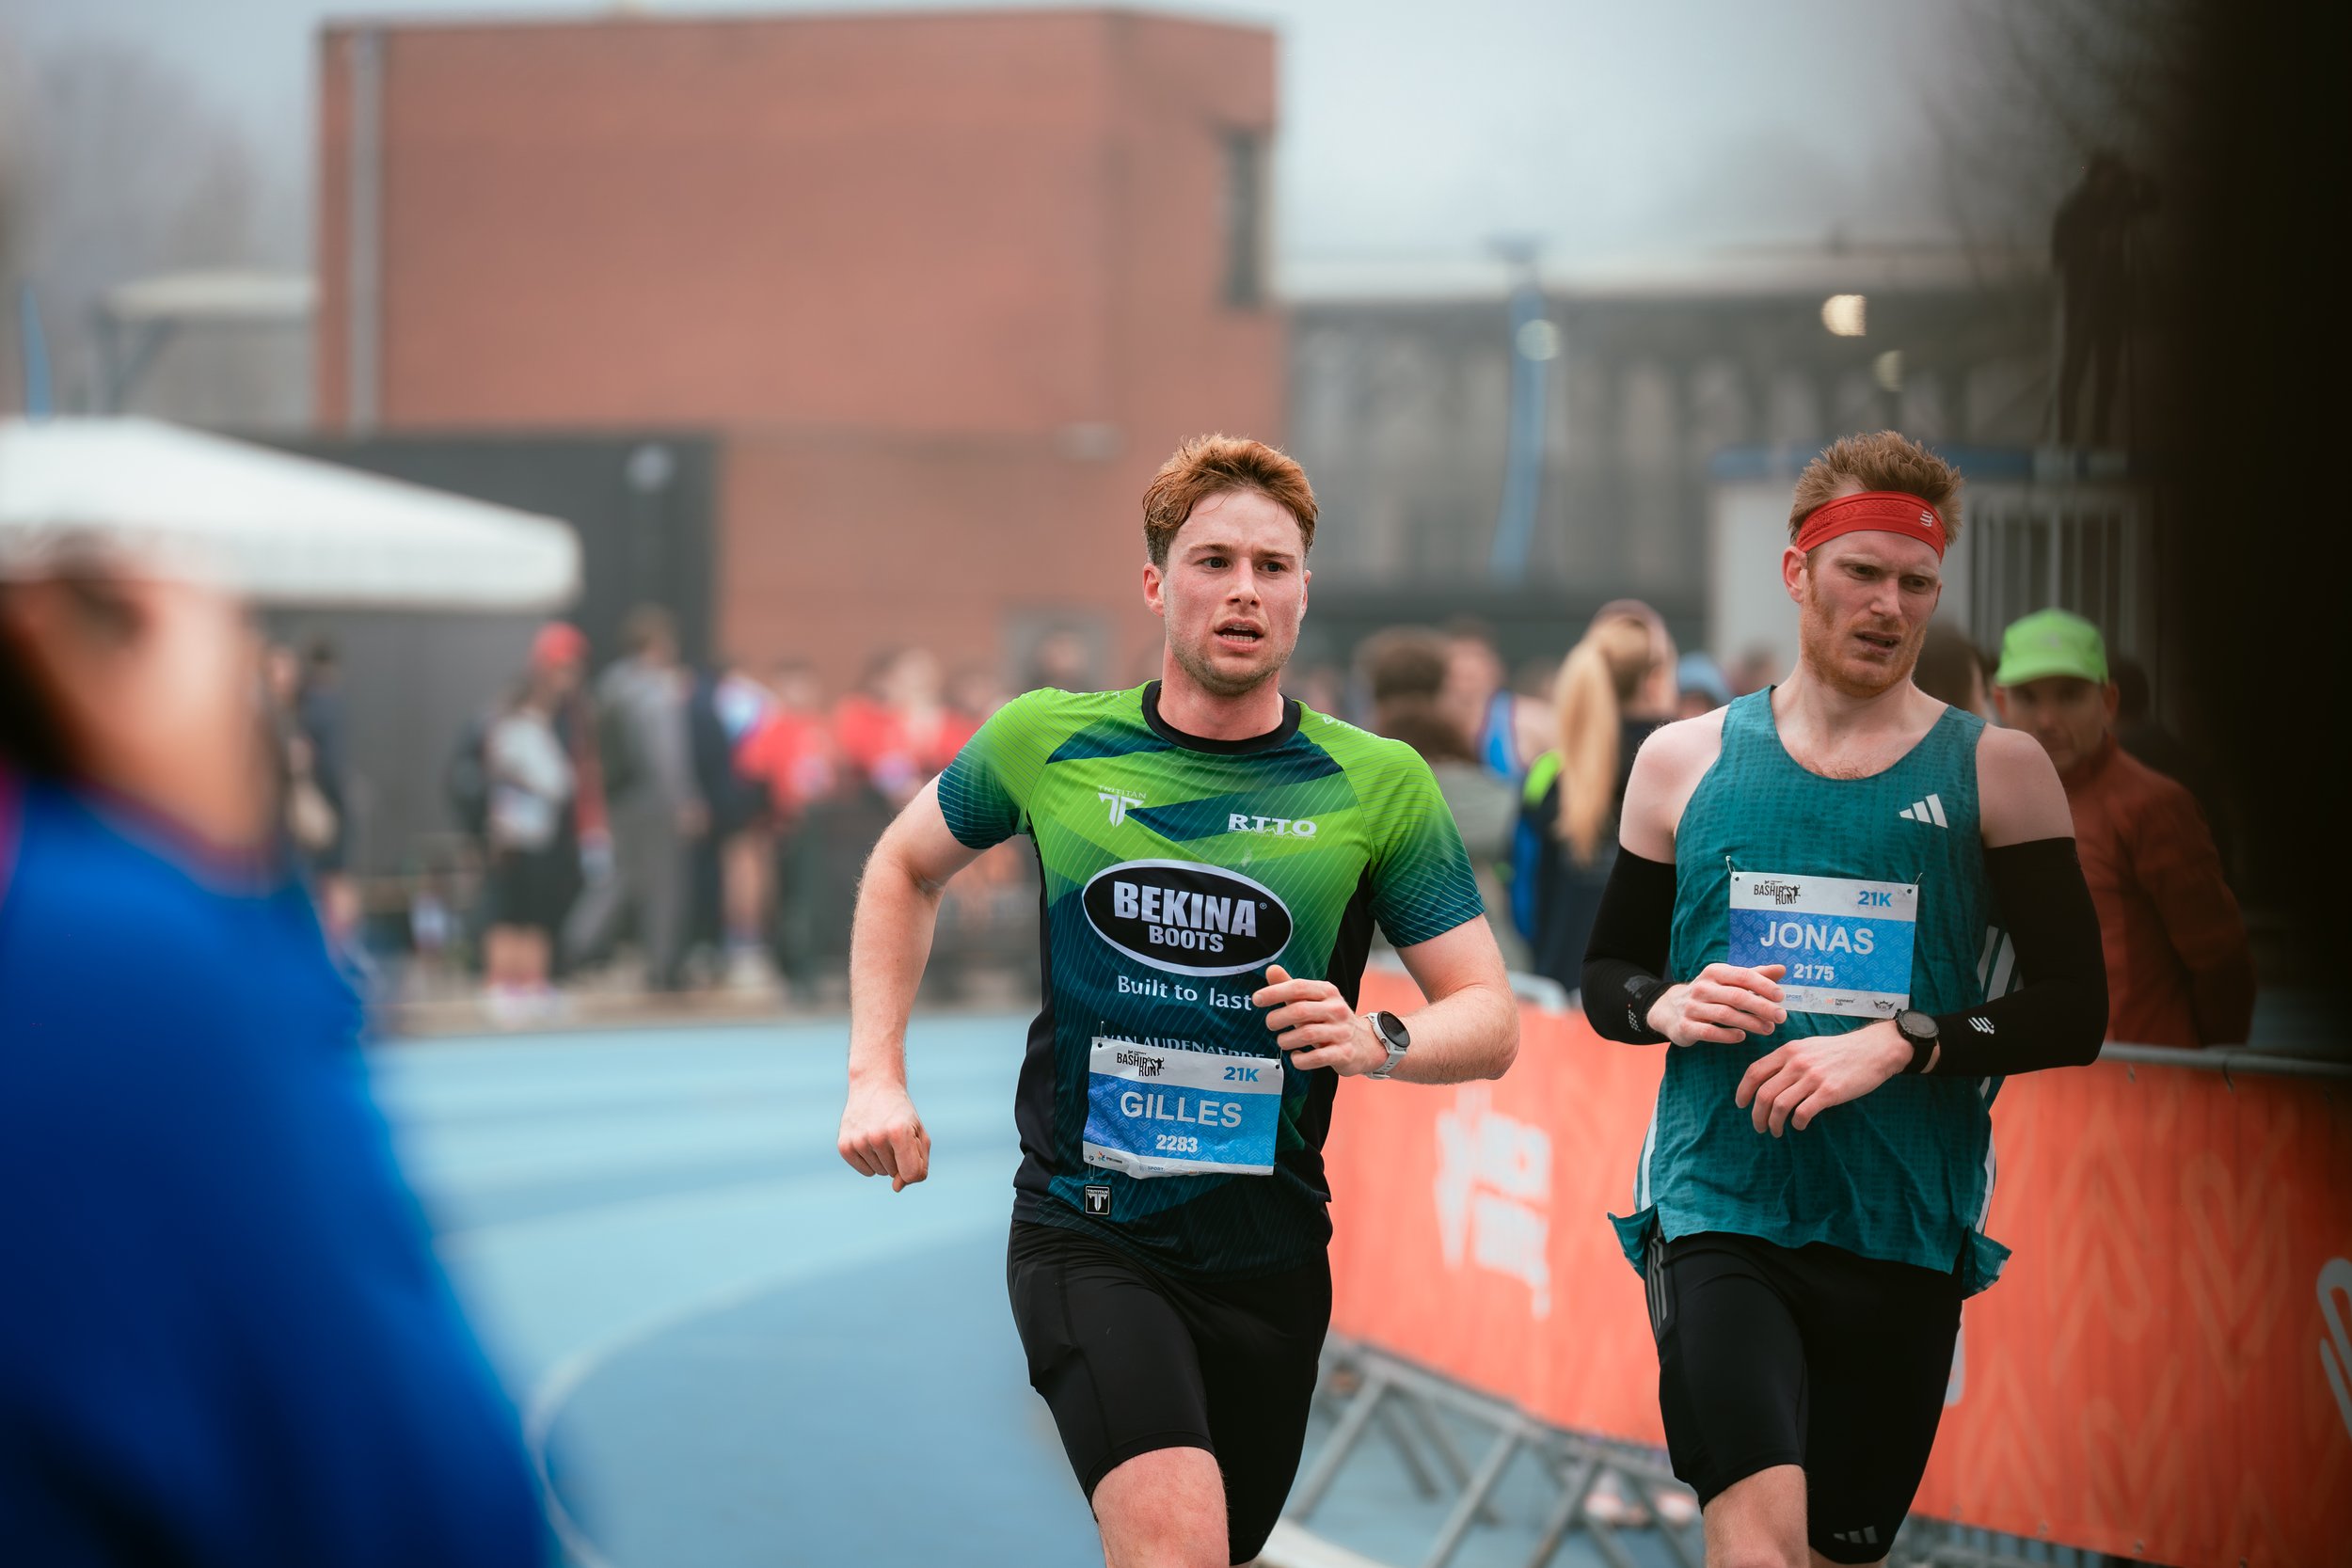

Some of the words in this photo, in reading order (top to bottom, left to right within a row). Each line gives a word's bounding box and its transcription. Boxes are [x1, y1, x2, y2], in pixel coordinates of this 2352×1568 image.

[1229, 813, 1317, 835] RTTO
[1113, 880, 1257, 938] BEKINA
[1775, 893, 1793, 905] RUN
[1857, 890, 1893, 908] 21K
[1149, 925, 1224, 953] BOOTS
[1759, 921, 1875, 955] JONAS
[1792, 963, 1835, 981] 2175
[1118, 974, 1168, 998] Built
[1174, 984, 1198, 1002] to
[1209, 987, 1252, 1011] last
[1138, 1065, 1157, 1077] RUN
[1223, 1066, 1260, 1083] 21K
[1120, 1091, 1243, 1128] GILLES
[1155, 1134, 1199, 1153] 2283
